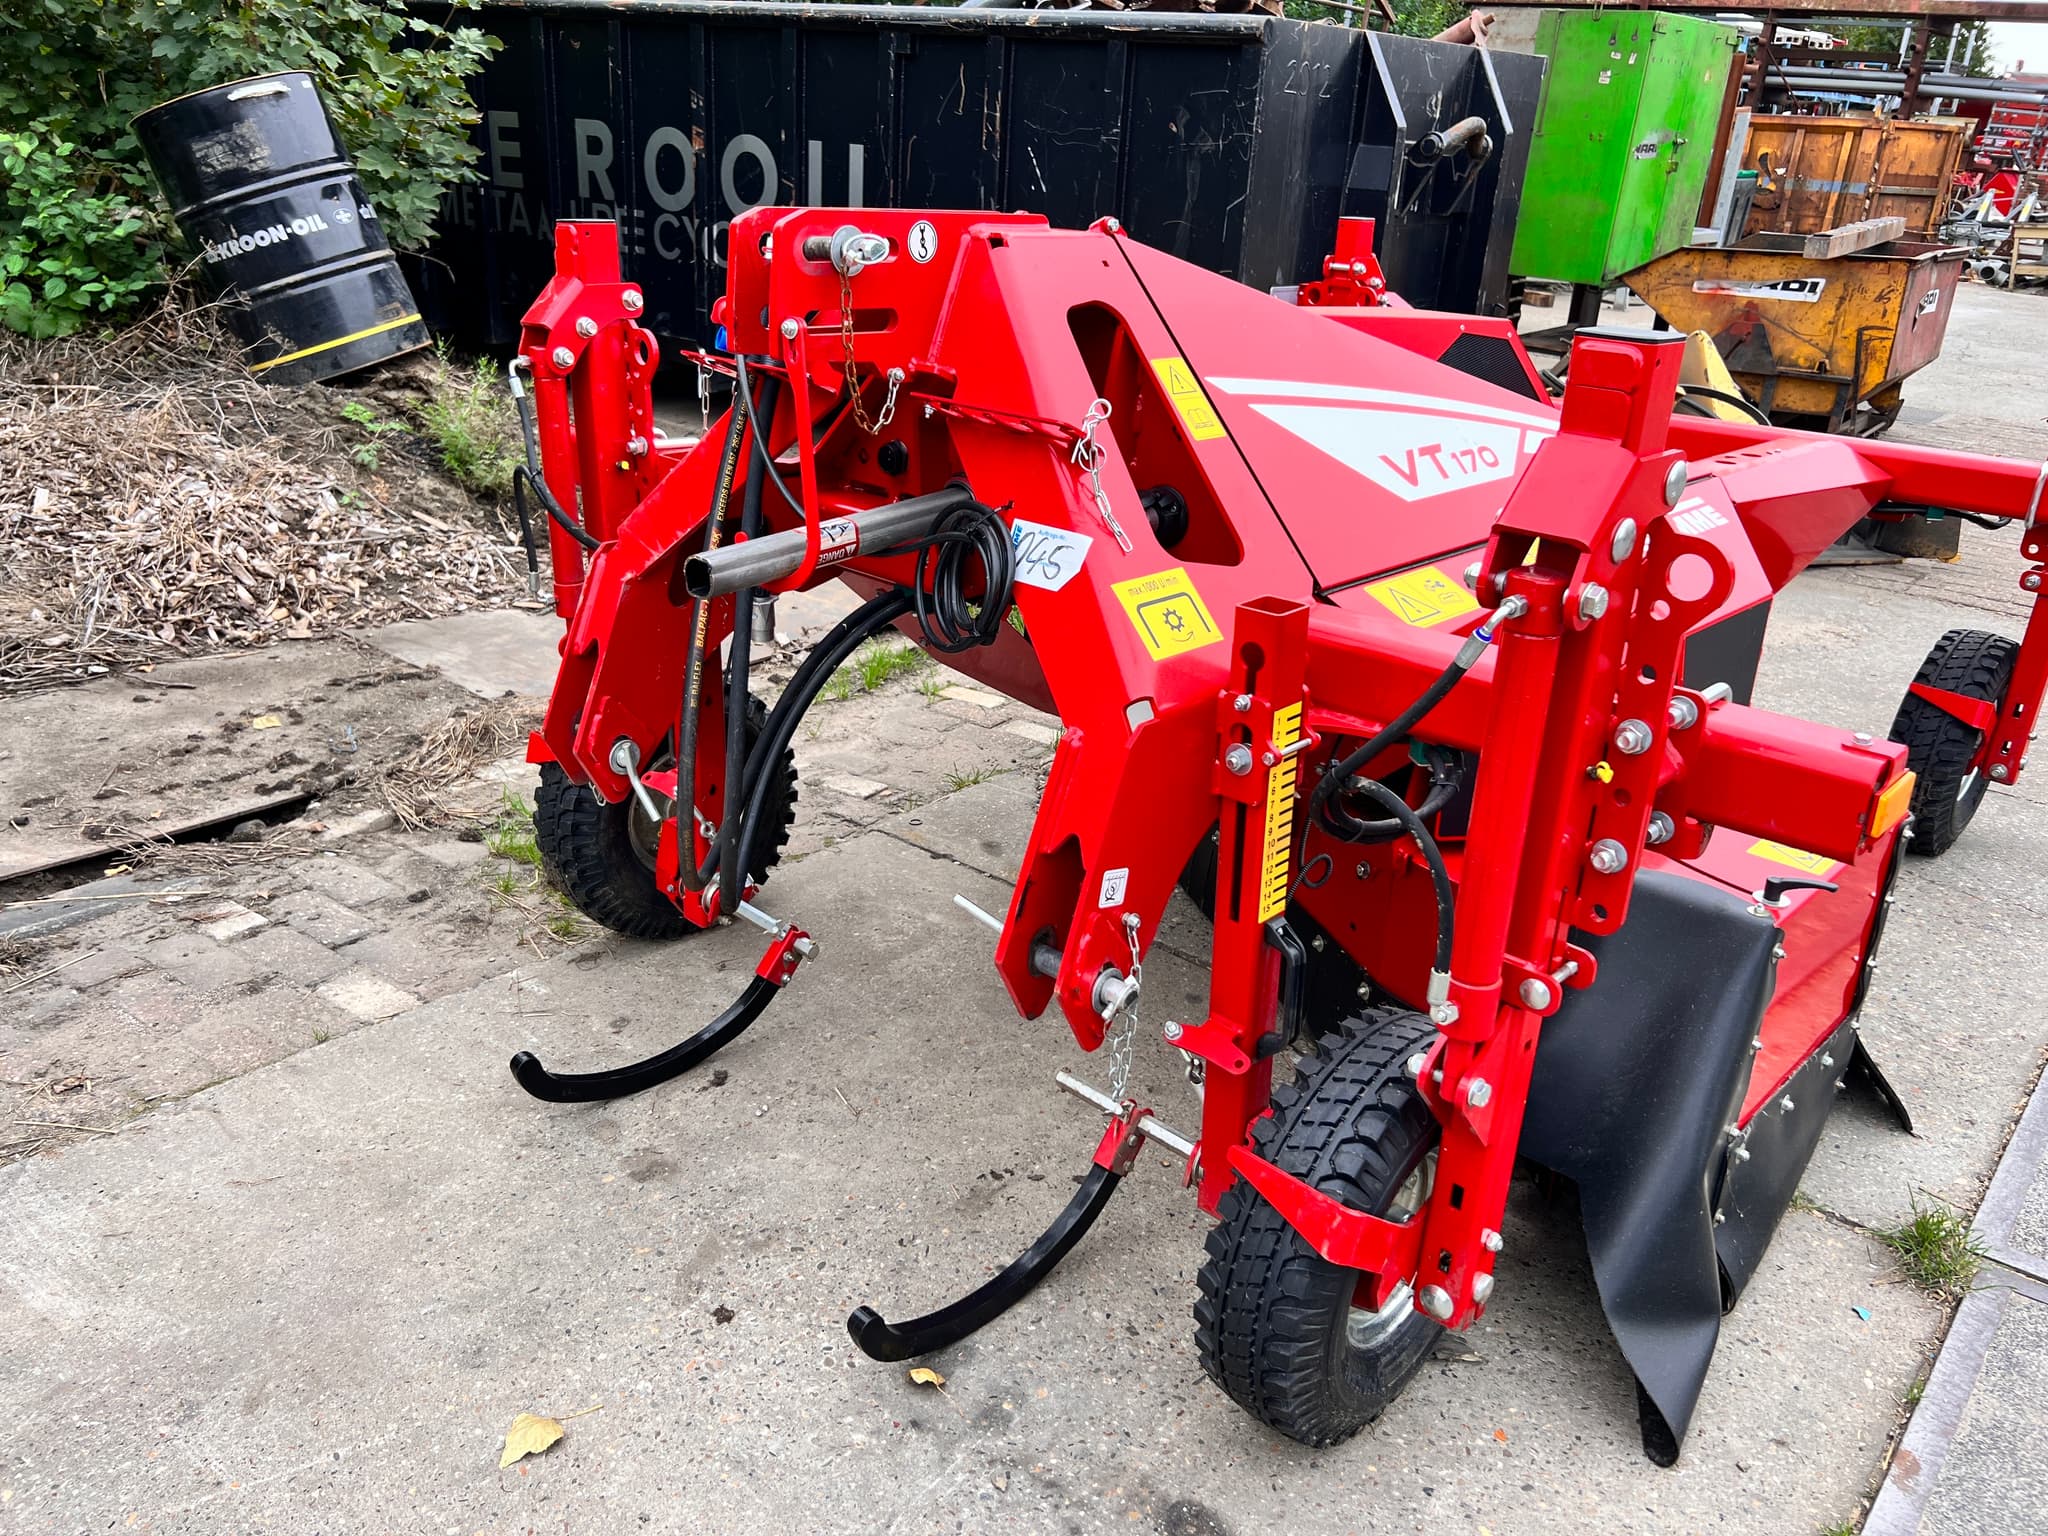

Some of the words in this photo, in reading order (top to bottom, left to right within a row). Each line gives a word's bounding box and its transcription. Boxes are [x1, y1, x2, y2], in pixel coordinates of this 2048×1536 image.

[736, 415, 746, 430] SAE
[725, 464, 735, 476] EN
[1378, 443, 1449, 487] VT
[1450, 446, 1499, 475] 170
[722, 476, 732, 488] DIN
[717, 489, 729, 521] EXCEEDS
[696, 610, 708, 647] BALPAC
[692, 660, 703, 695] BALFLEX
[1272, 772, 1277, 782] 5
[1271, 786, 1276, 796] 6
[1269, 813, 1274, 823] 8
[1268, 826, 1273, 836] 9
[1267, 838, 1276, 849] 10
[1266, 852, 1274, 862] 11
[1265, 865, 1274, 875] 12
[1264, 878, 1273, 889] 13
[1263, 891, 1272, 901] 14
[1263, 904, 1271, 914] 15
